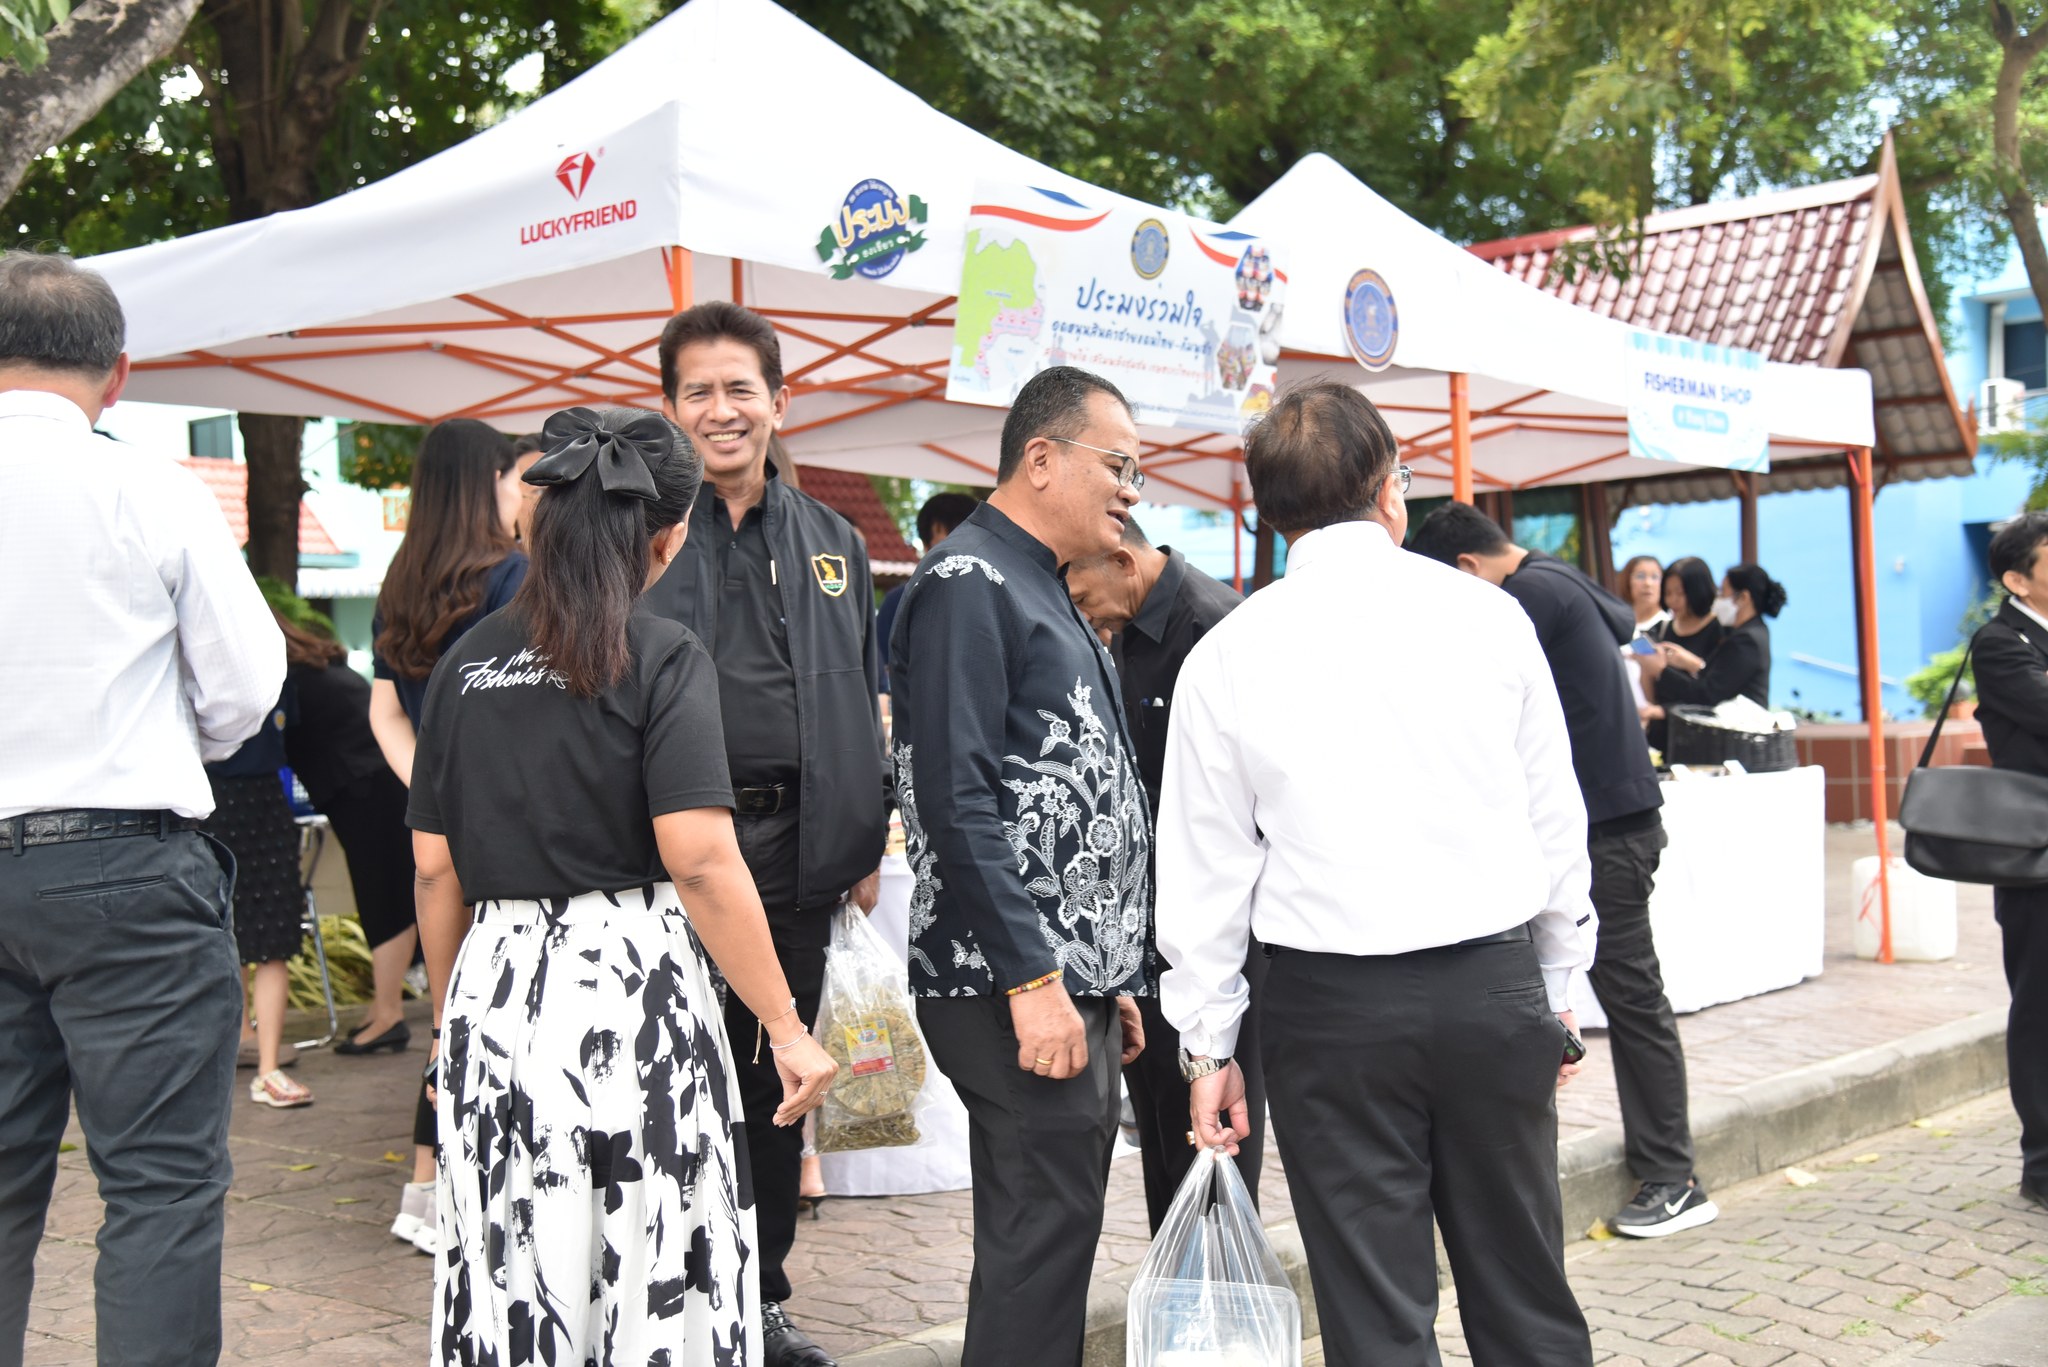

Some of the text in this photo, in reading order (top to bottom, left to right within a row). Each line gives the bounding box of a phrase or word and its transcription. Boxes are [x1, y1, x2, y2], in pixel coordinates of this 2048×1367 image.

[519, 199, 638, 246] LUCKYFRIEND
[833, 197, 911, 249] ประมง
[1075, 277, 1204, 328] ประมงร่วมใจ
[1644, 371, 1753, 405] FISHERMAN SHOP
[512, 645, 542, 667] We
